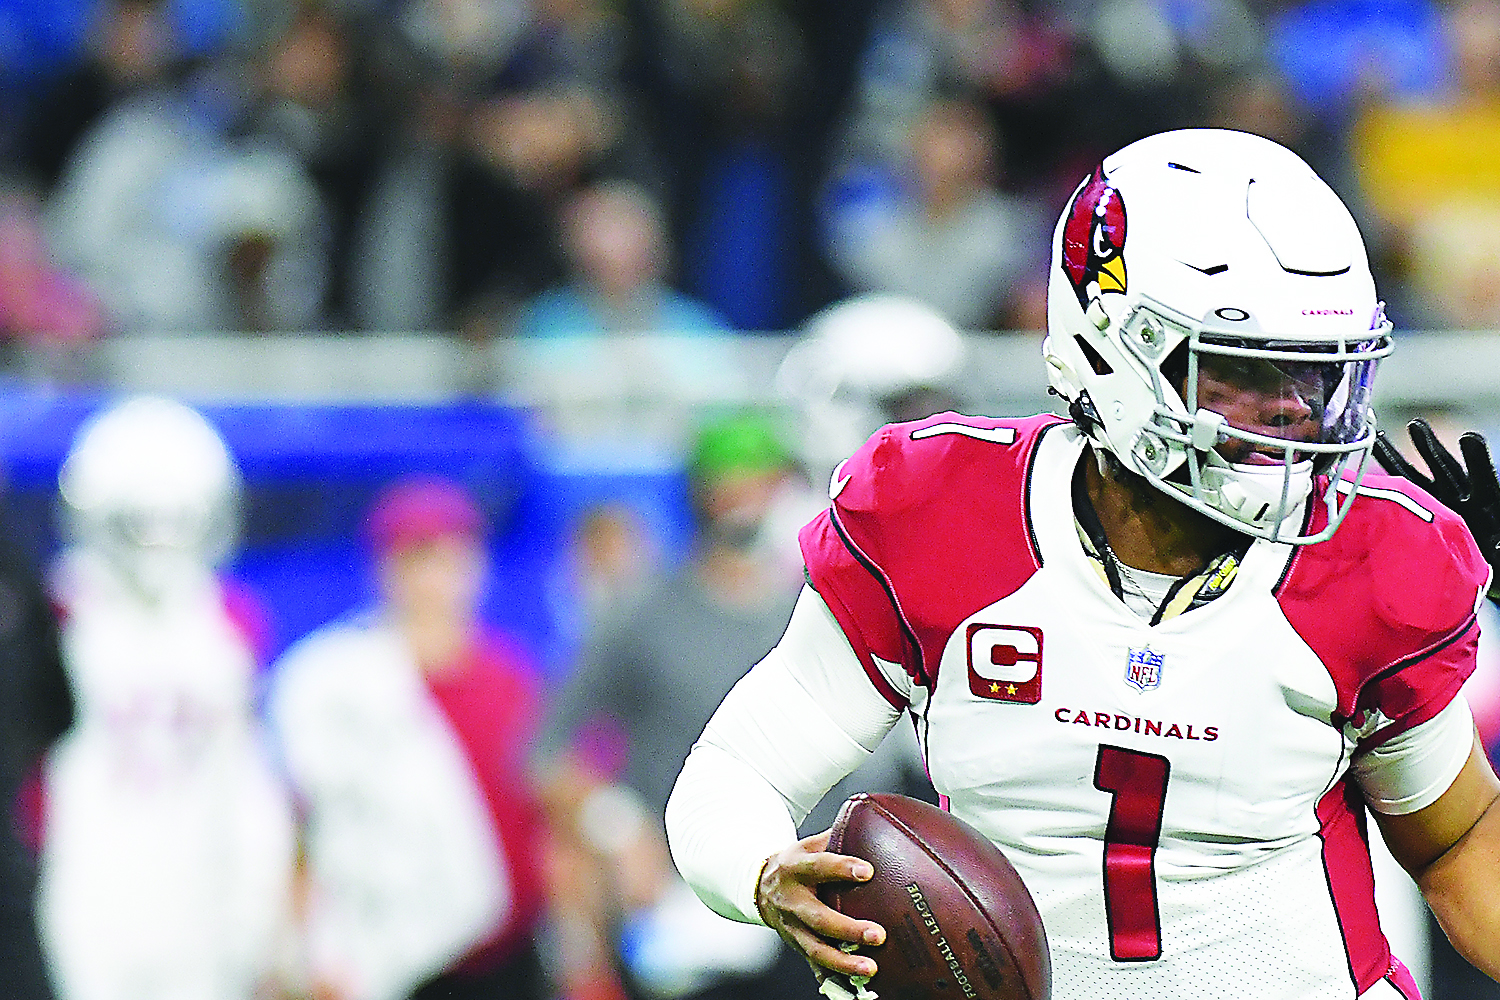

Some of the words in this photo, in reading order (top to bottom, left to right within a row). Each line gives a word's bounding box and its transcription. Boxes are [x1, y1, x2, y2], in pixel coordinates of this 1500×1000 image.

[910, 422, 1016, 445] 1
[971, 628, 1039, 683] C
[1130, 665, 1157, 685] NFL
[1054, 708, 1219, 742] CARDINALS
[1092, 743, 1171, 962] 1
[907, 882, 941, 936] LEAGUE
[936, 937, 977, 999] FOOTBALL
